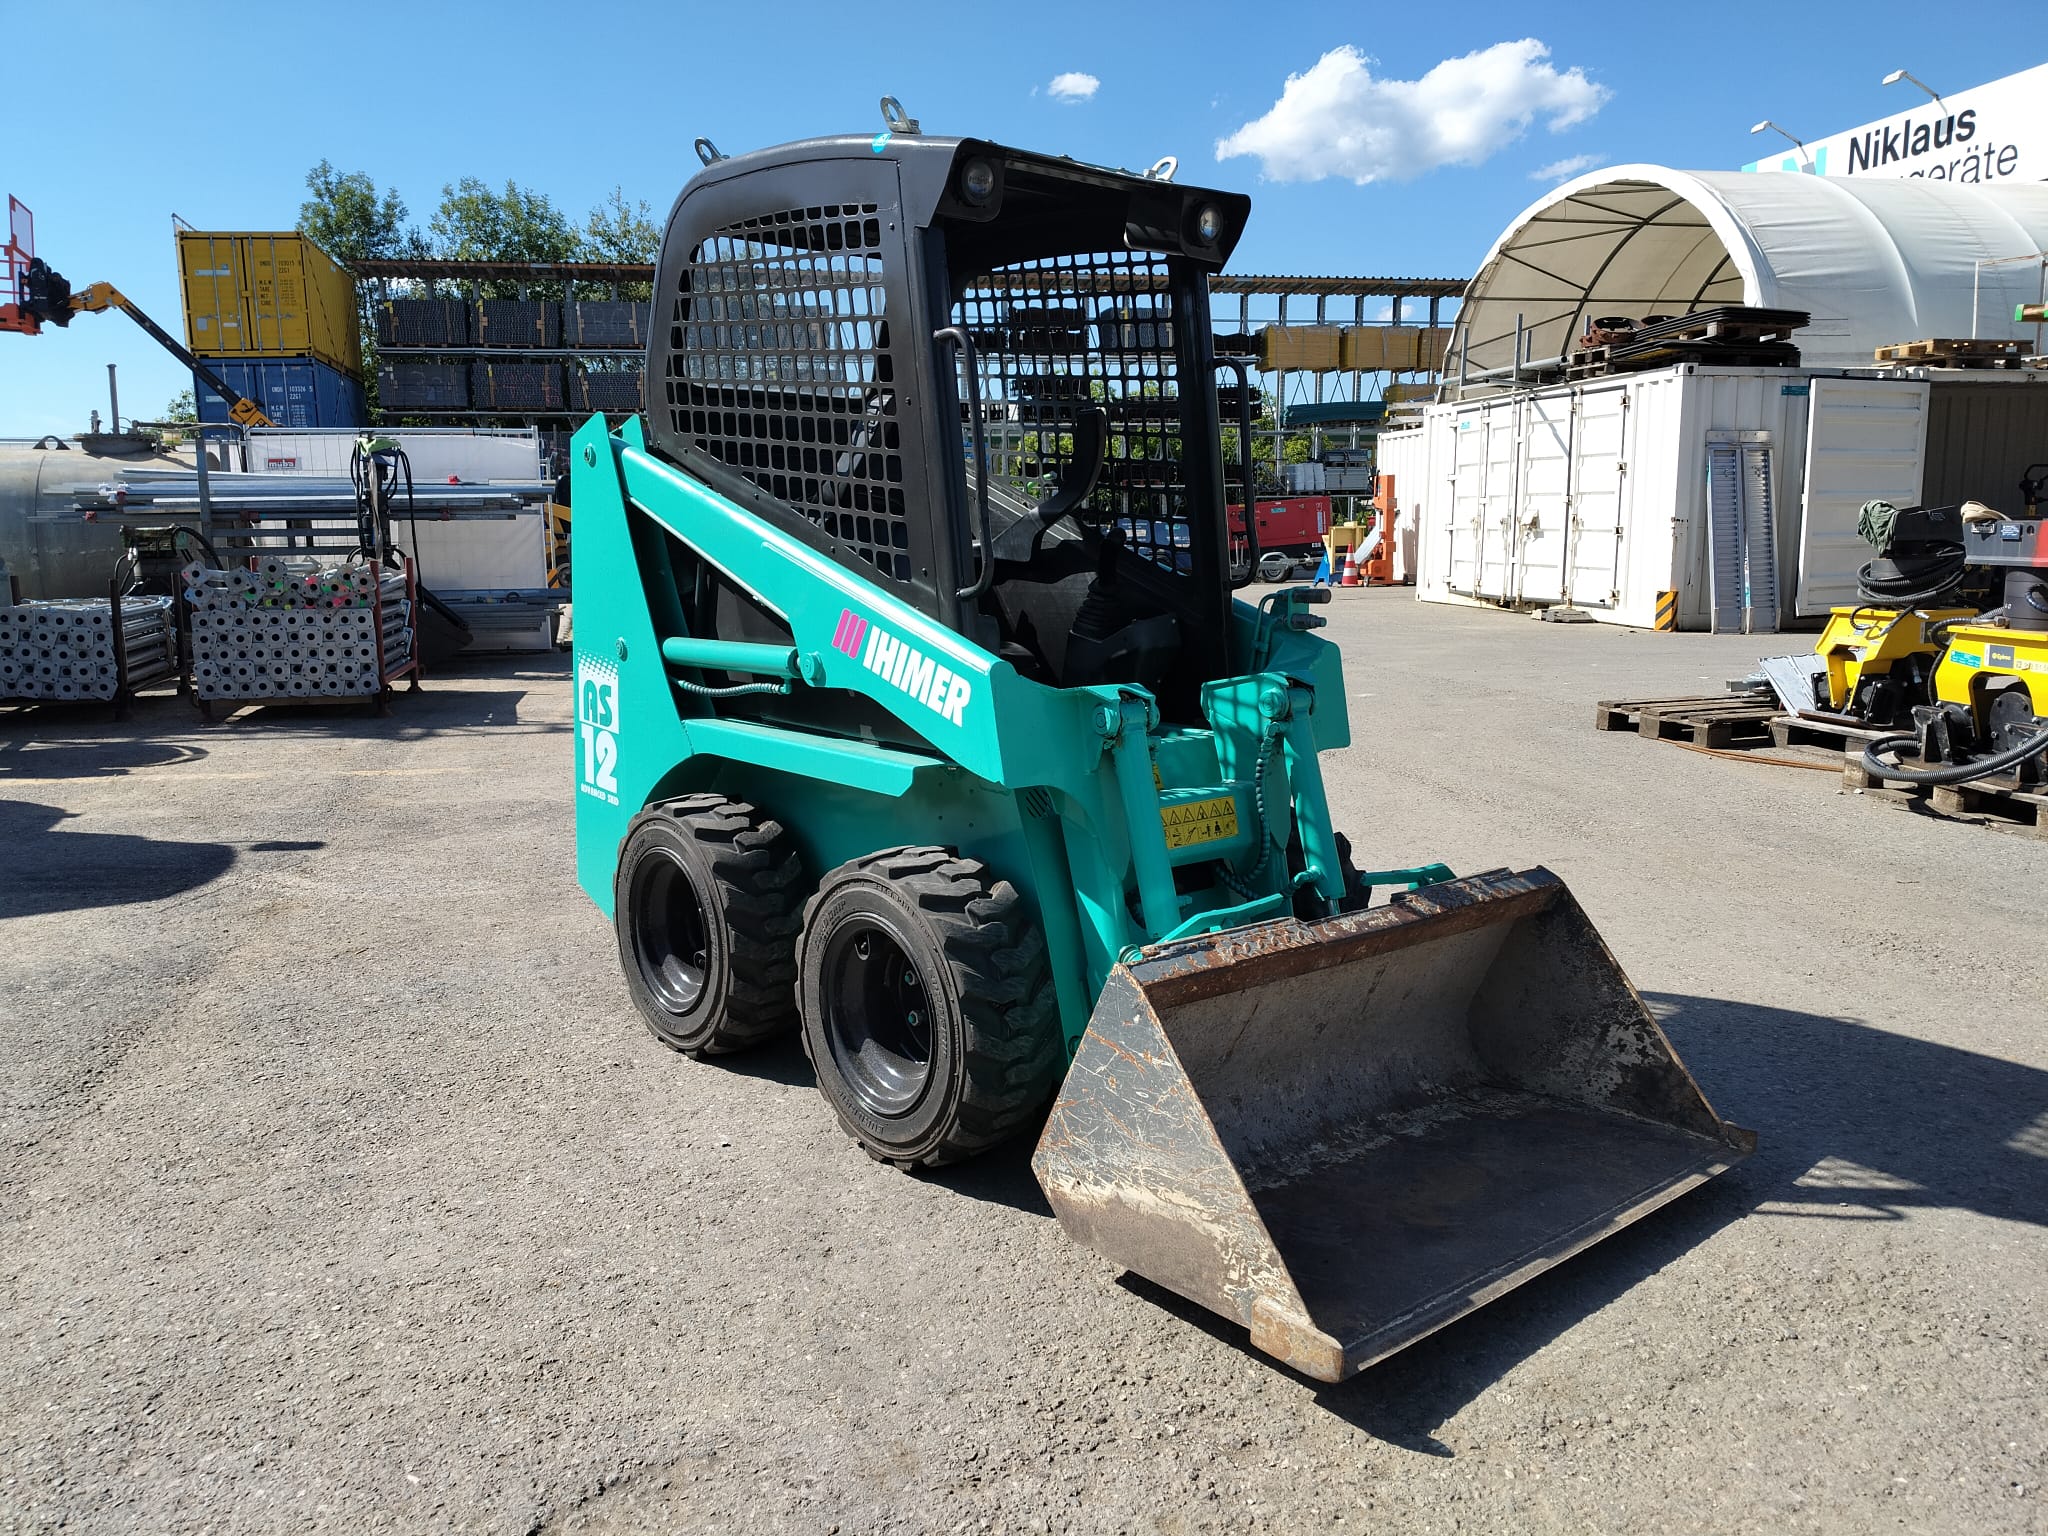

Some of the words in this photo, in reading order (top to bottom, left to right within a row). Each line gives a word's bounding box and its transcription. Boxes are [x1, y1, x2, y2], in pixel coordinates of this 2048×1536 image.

[1848, 109, 1976, 175] Niklaus
[583, 680, 612, 727] AS
[863, 624, 972, 728] IHIMER
[581, 723, 618, 794] 12
